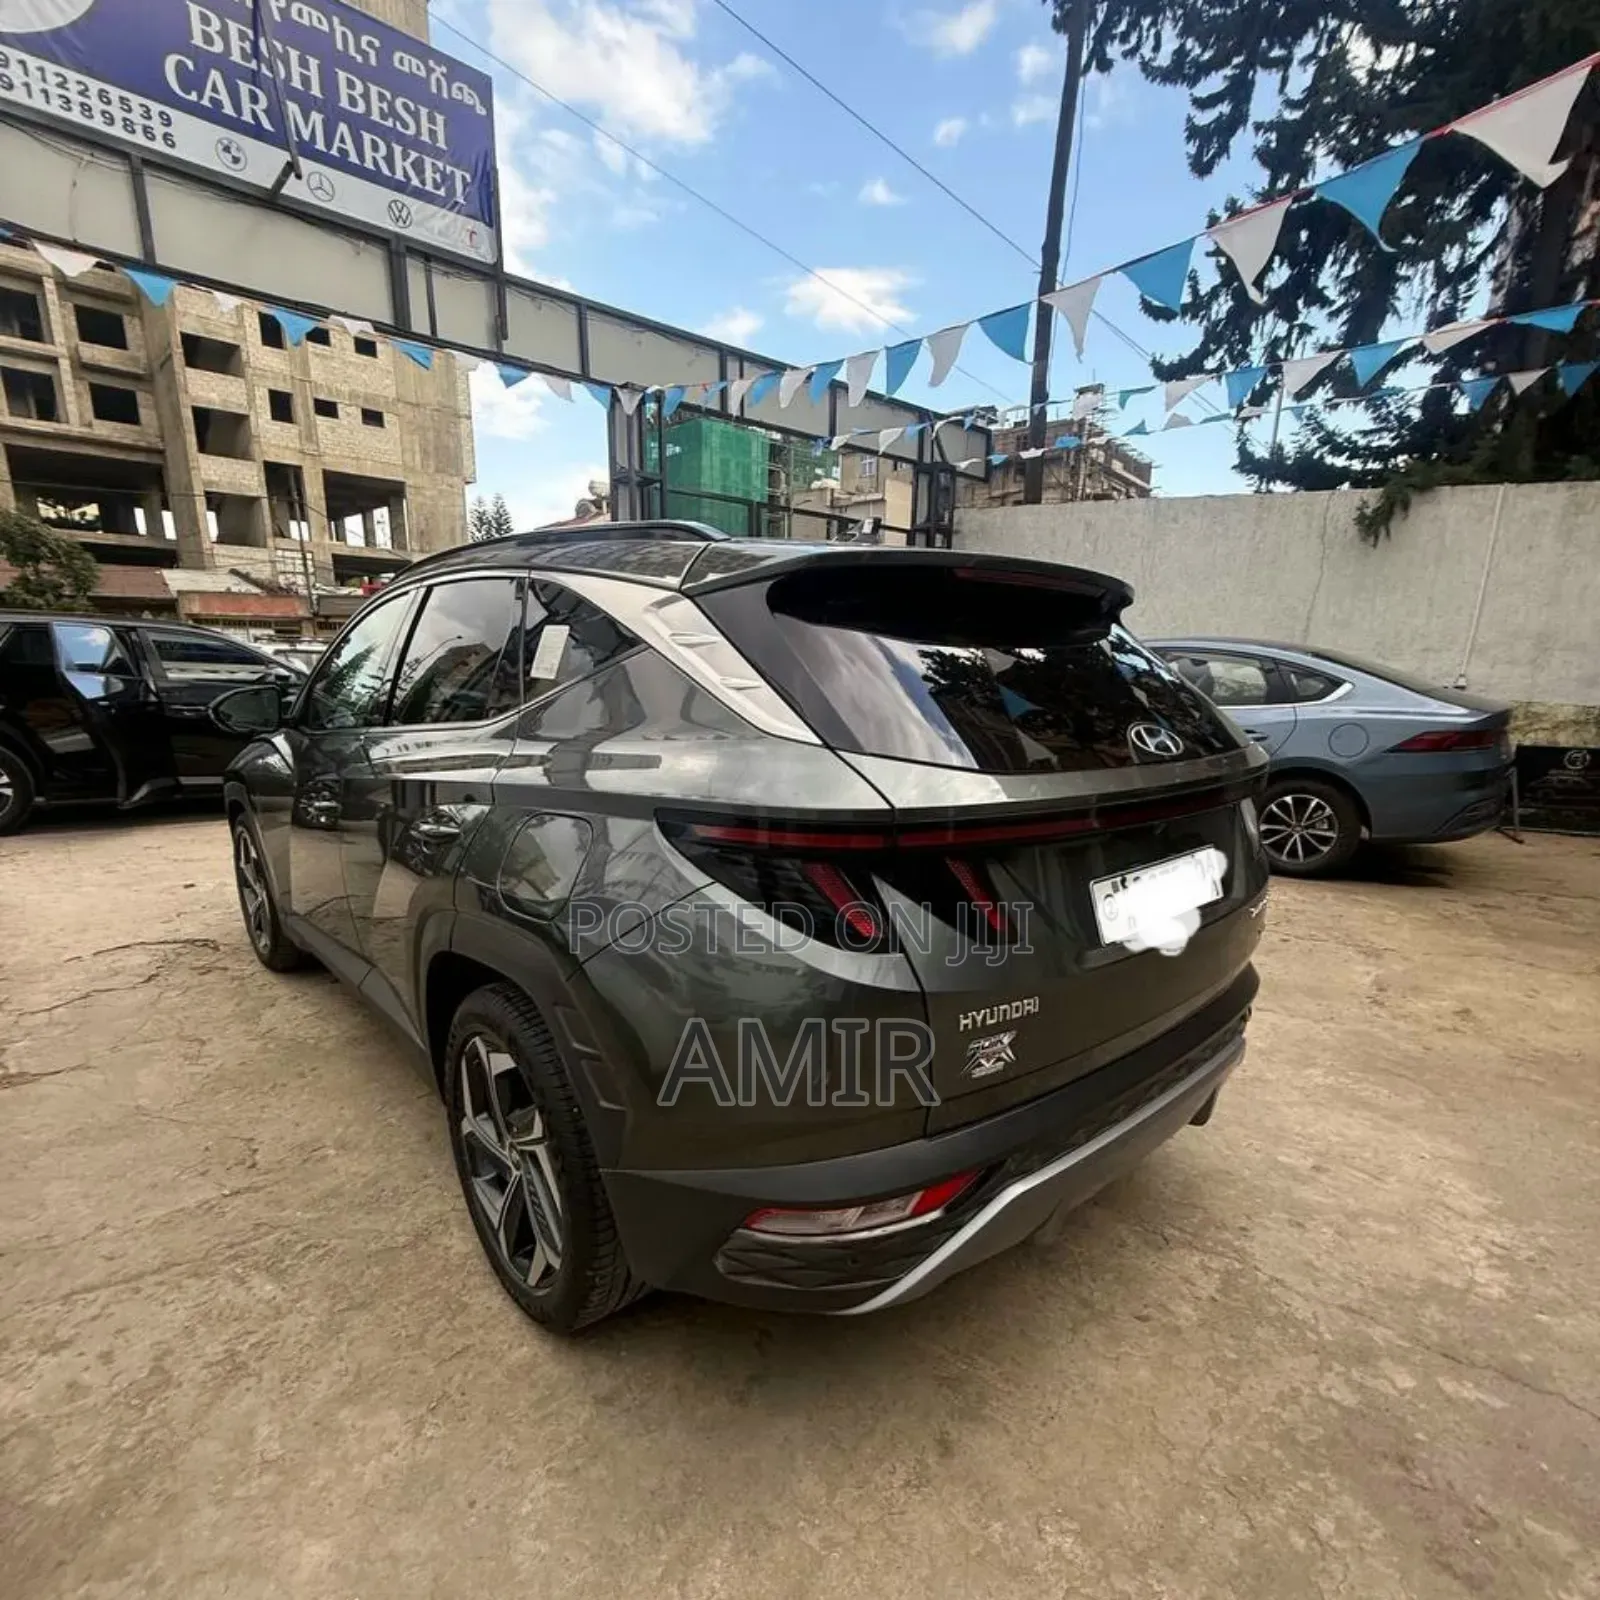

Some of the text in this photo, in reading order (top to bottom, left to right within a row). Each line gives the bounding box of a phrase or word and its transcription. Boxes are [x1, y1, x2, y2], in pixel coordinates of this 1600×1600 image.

[0, 73, 176, 149] 911389866
[164, 53, 472, 205] CAR MARKET
[186, 0, 447, 150] BESH BESH
[959, 996, 1040, 1031] HYUNDAI
